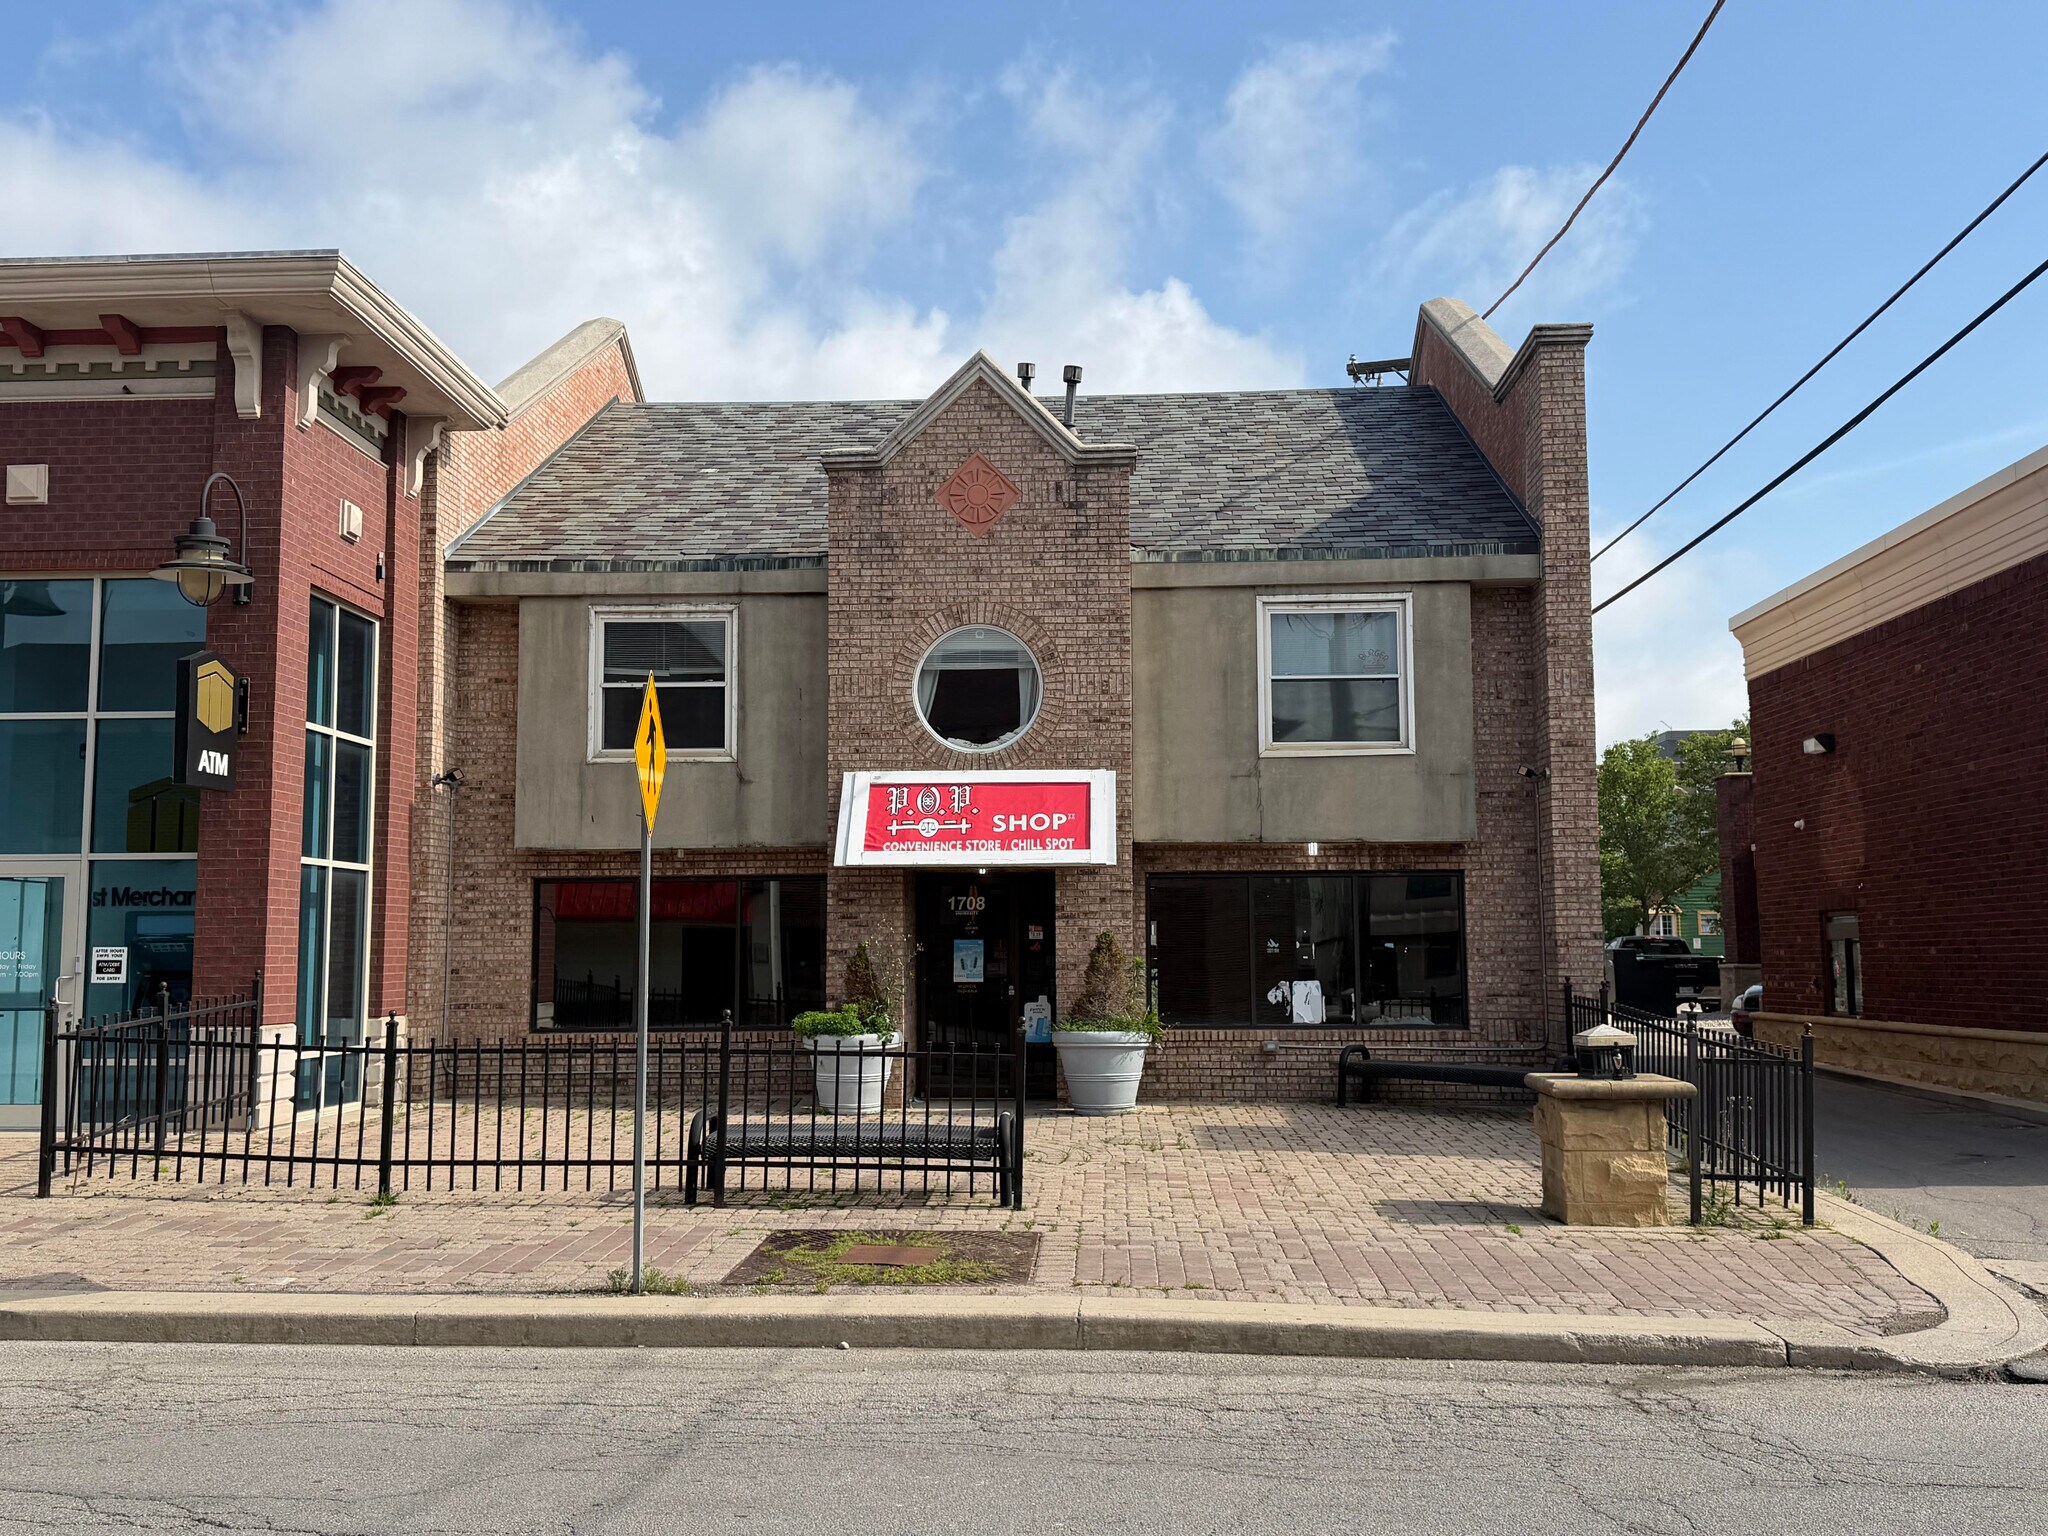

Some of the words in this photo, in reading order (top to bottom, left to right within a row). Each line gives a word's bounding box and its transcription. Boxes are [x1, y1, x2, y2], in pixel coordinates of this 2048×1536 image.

[1358, 648, 1389, 661] BURGER
[197, 749, 228, 777] ATM
[992, 813, 1067, 832] SHOP
[883, 840, 962, 851] CONVENIENCE
[965, 838, 1001, 851] STORE
[1010, 838, 1043, 850] CHILL
[1045, 837, 1075, 850] SPOT
[948, 896, 986, 910] 1708
